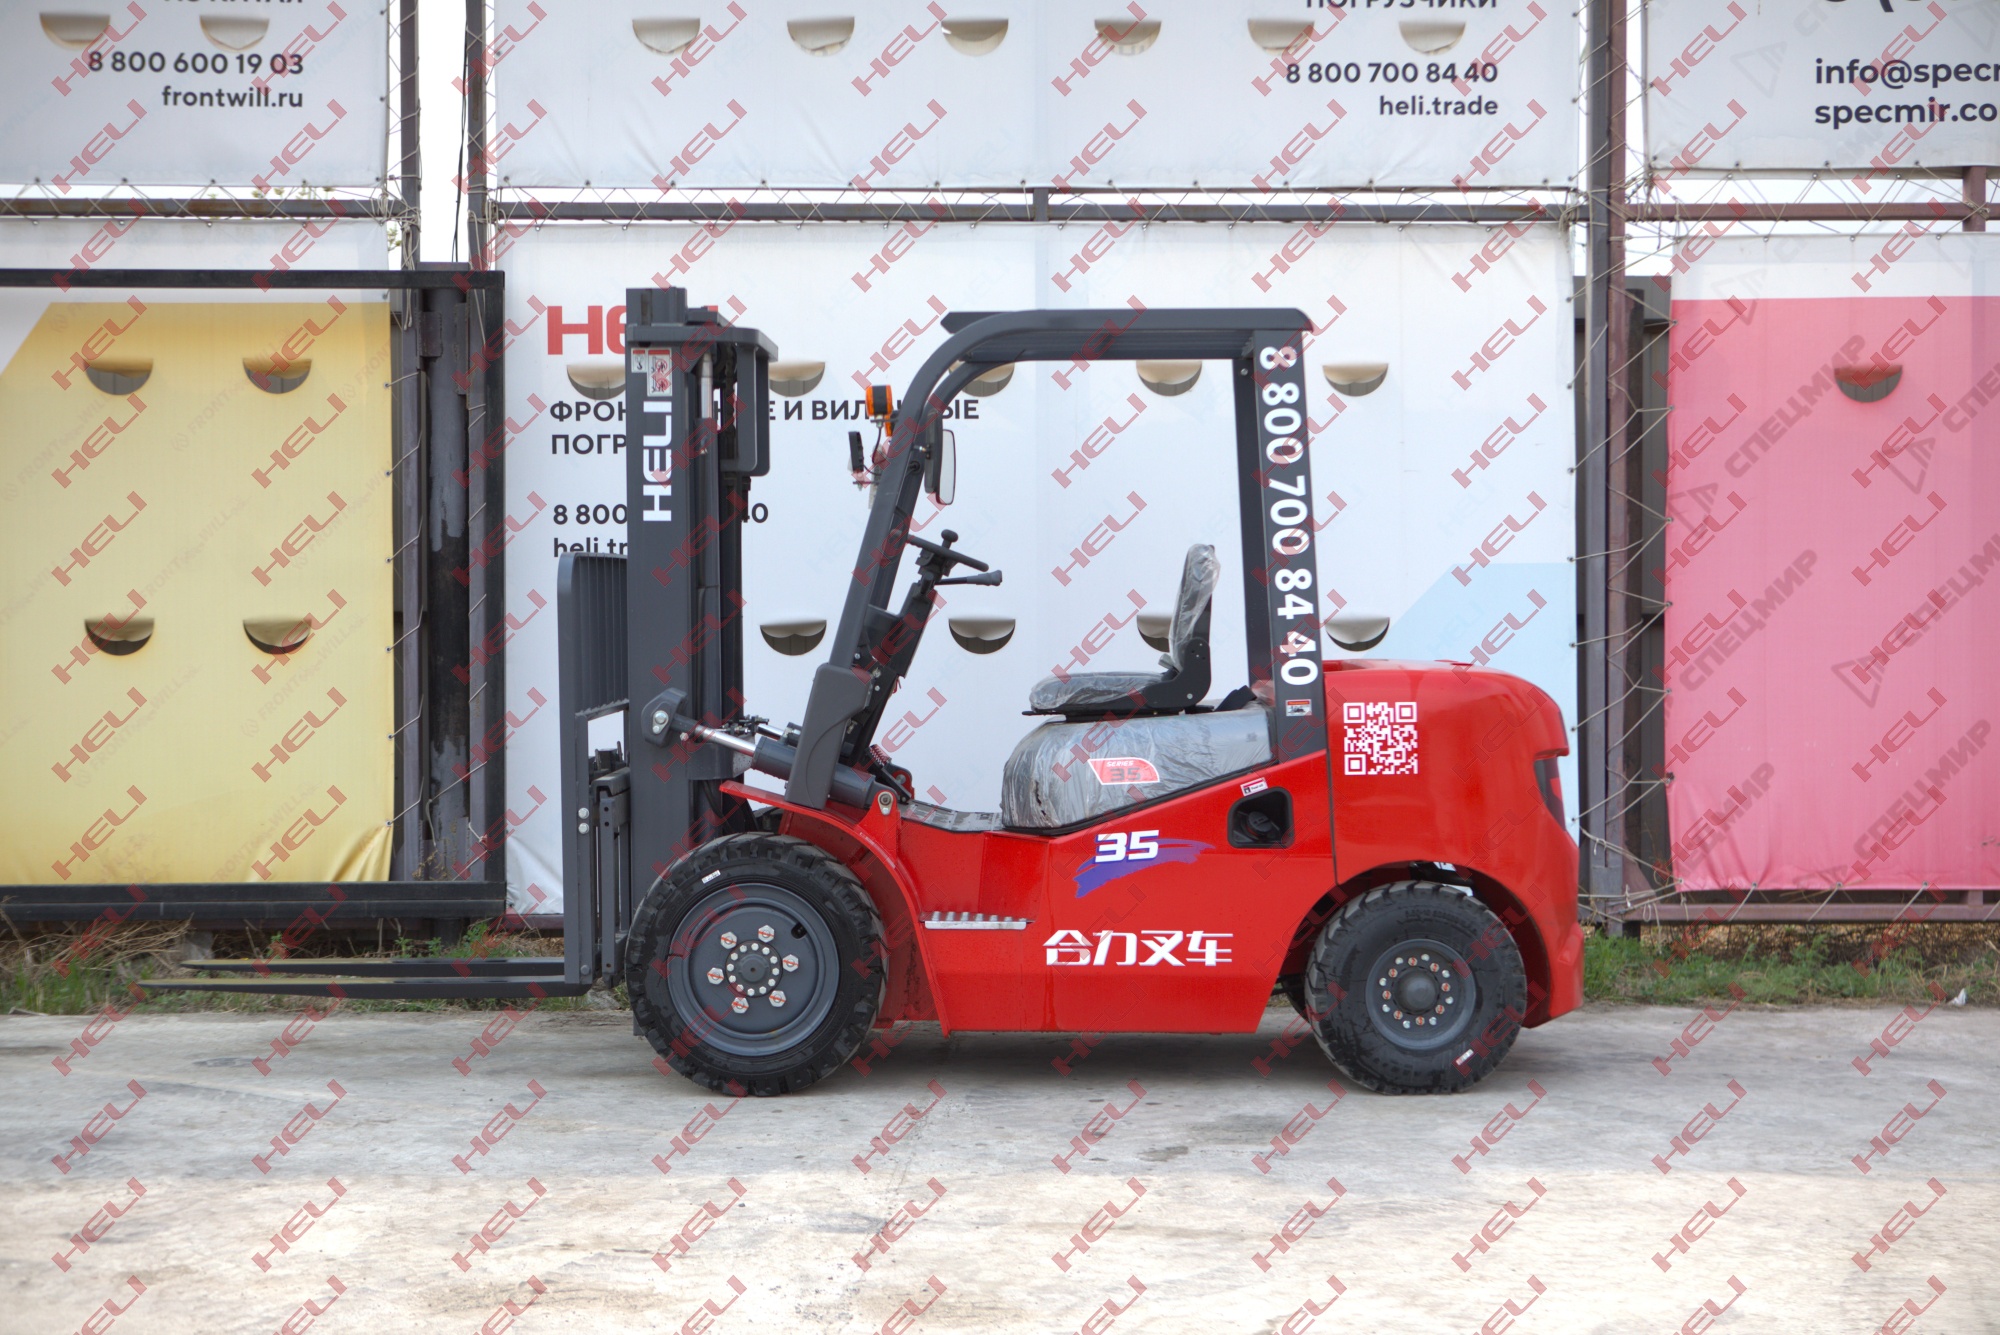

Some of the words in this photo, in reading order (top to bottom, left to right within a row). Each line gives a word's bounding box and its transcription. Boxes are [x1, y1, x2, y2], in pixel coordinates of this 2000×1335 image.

[89, 51, 103, 72] 8
[111, 51, 166, 73] 800
[173, 53, 229, 74] 600
[236, 54, 262, 75] 19
[270, 54, 304, 75] 03
[1285, 62, 1301, 84] 8
[1307, 62, 1361, 84] 800
[1368, 62, 1419, 84] 700
[1425, 62, 1457, 84] 84
[1463, 62, 1498, 84] 40
[1815, 58, 2000, 90] info@spec
[162, 85, 303, 107] frontwill.ru
[1378, 95, 1498, 116] heli.trade
[1814, 96, 1998, 130] specmir.co
[1259, 345, 1298, 370] 8
[784, 400, 803, 421] И
[1261, 382, 1304, 465] 800
[643, 401, 672, 522] HELI
[553, 504, 568, 526] 8
[1267, 474, 1310, 556] 700
[1274, 567, 1315, 620] 84
[1279, 630, 1319, 686] 40
[1106, 760, 1134, 768] SERIES
[1109, 767, 1142, 782] 35
[1094, 829, 1160, 863] 35
[1042, 929, 1234, 967] 合力叉车
